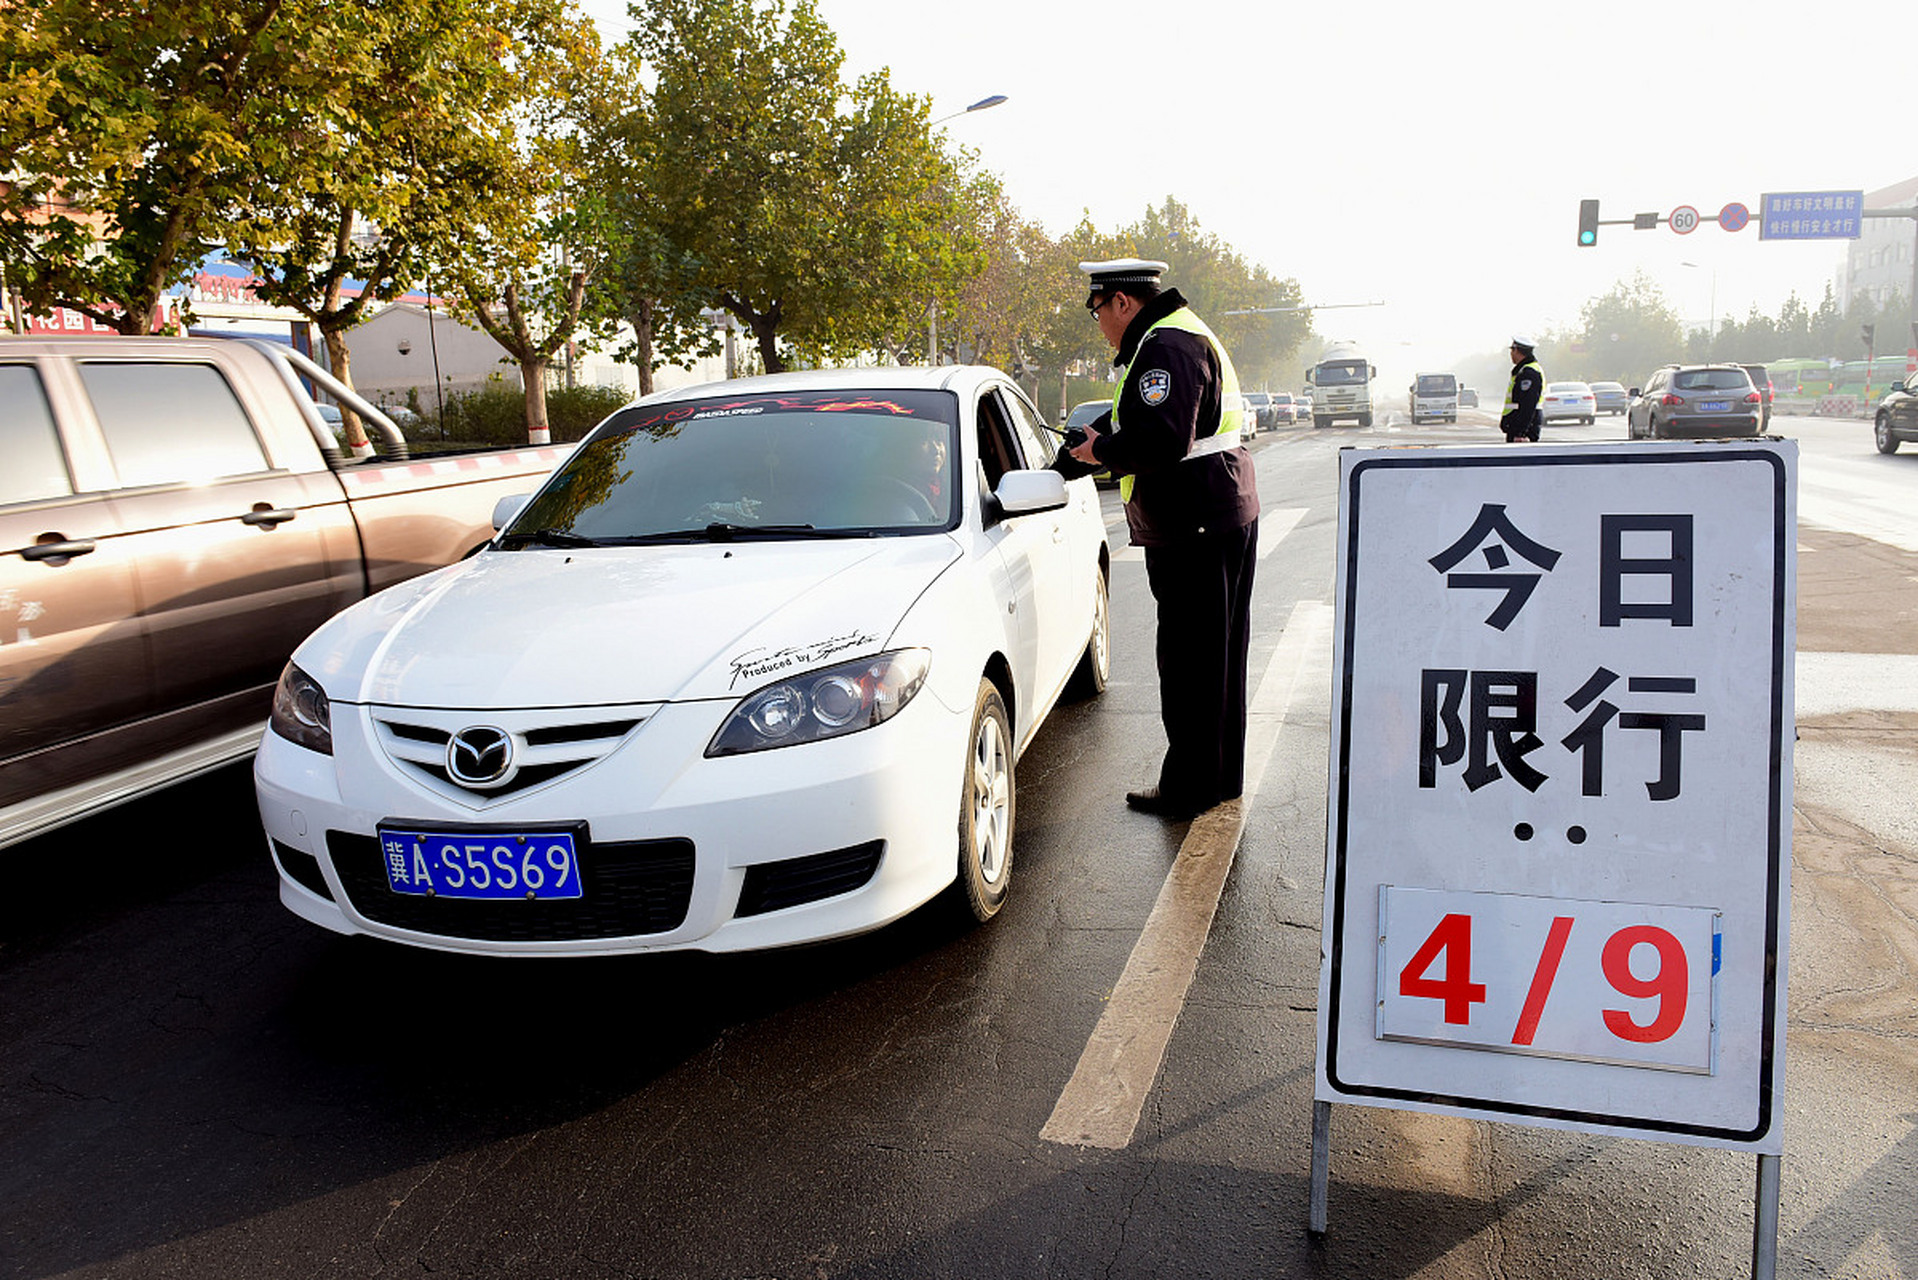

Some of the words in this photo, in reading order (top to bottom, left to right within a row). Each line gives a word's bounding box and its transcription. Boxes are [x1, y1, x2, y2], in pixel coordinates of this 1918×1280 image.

[1675, 213, 1694, 228] 60
[1428, 503, 1694, 631] 今日
[742, 657, 793, 679] Produced
[795, 652, 812, 663] by
[1419, 666, 1706, 801] 限行
[1400, 913, 1689, 1045] 4/9
